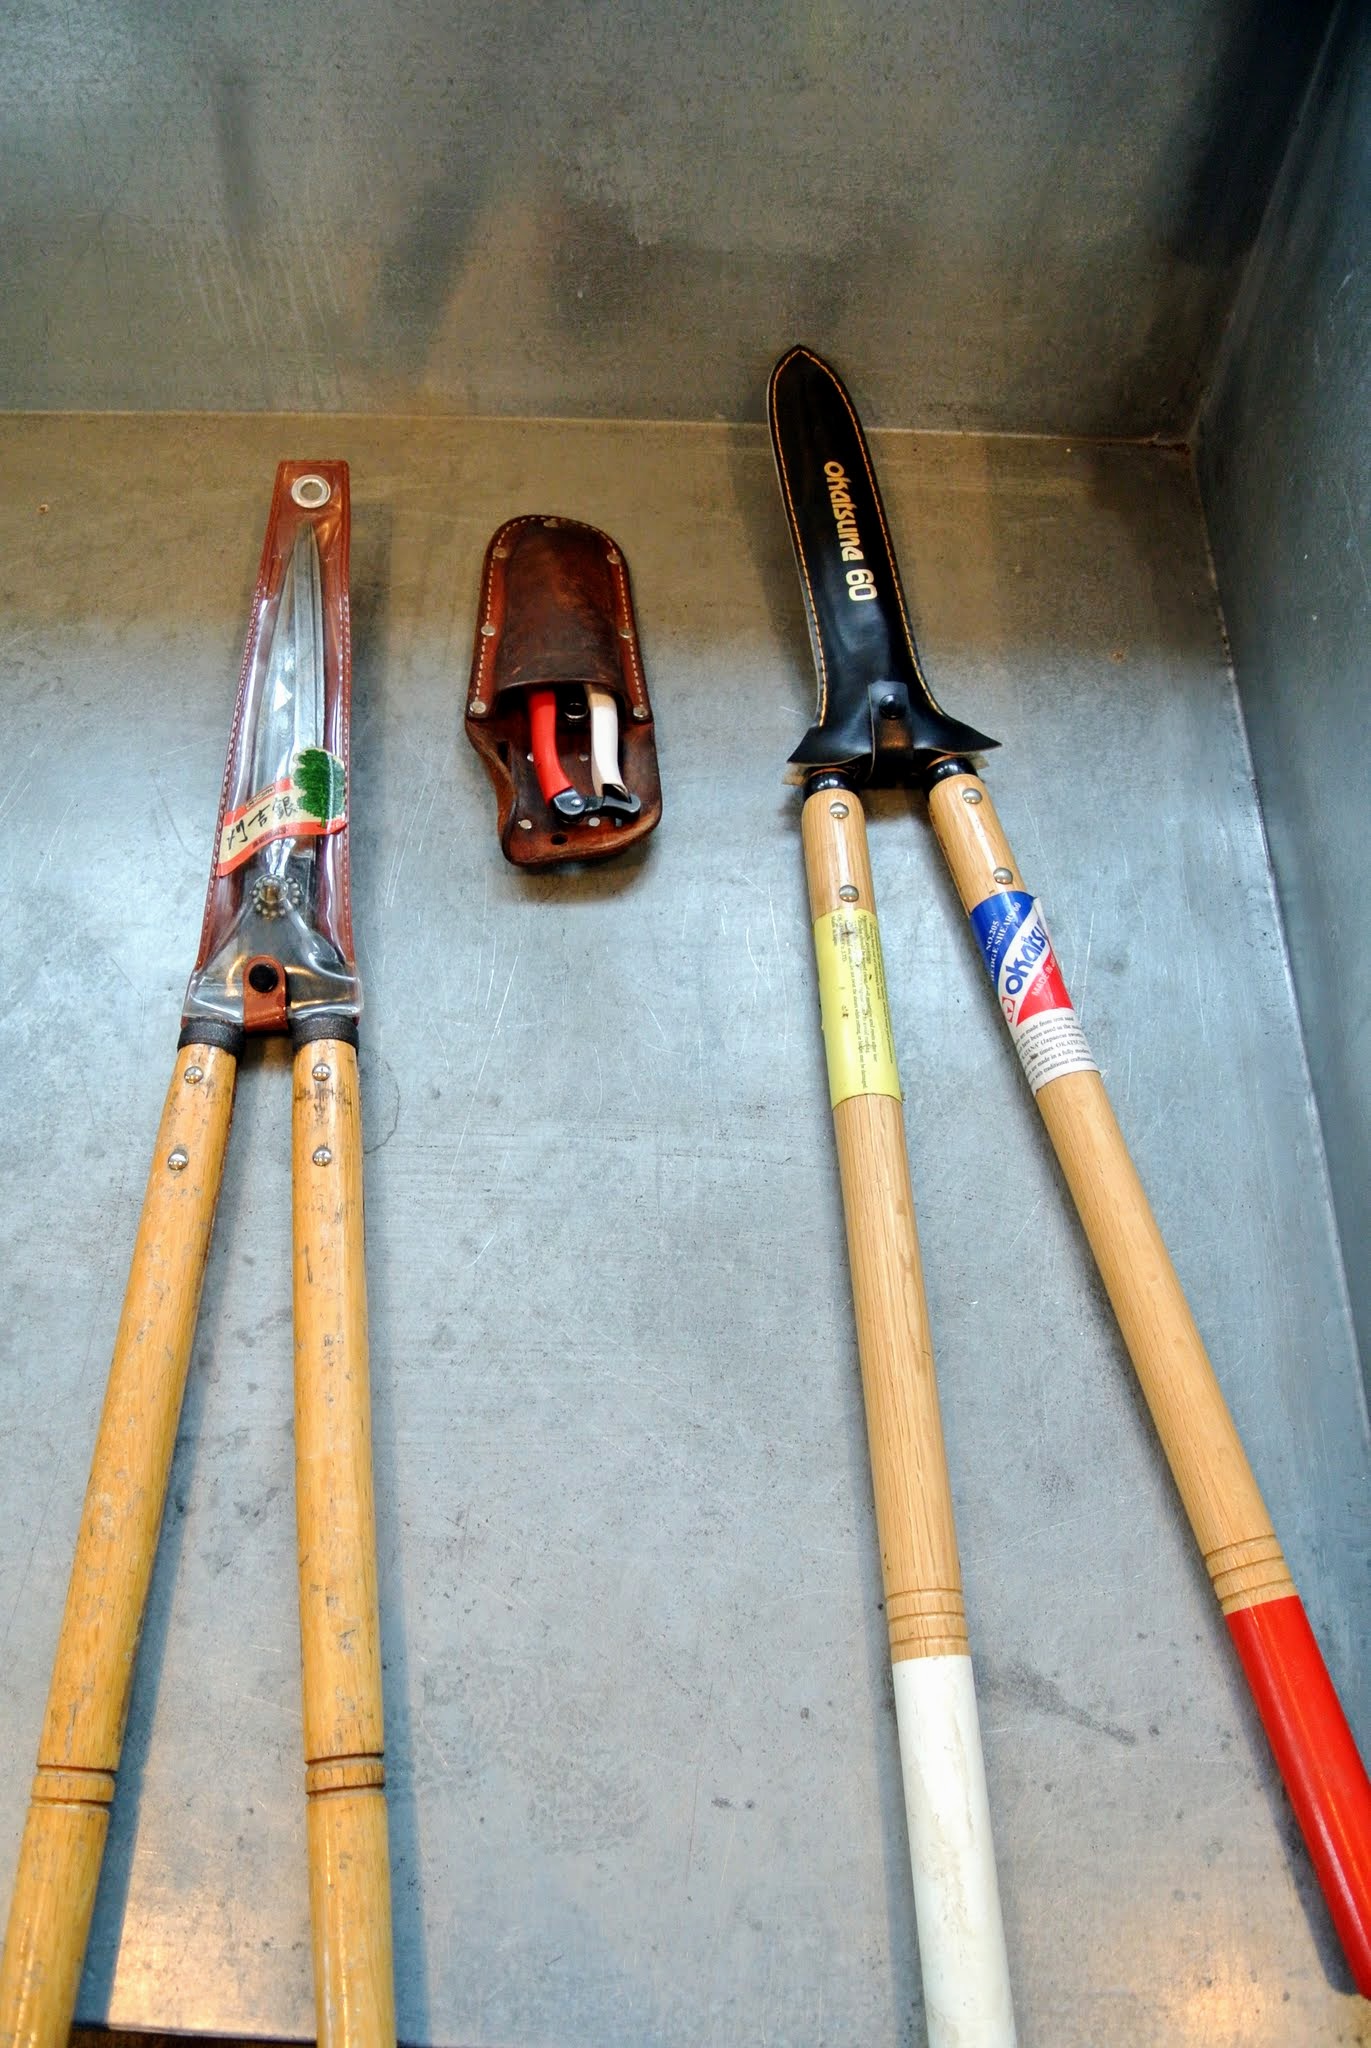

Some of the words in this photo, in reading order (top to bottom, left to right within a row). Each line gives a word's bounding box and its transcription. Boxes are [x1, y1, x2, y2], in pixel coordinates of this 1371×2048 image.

[824, 461, 864, 562] okatsune
[845, 568, 878, 602] 60
[1013, 902, 1022, 912] 60
[986, 920, 999, 951] NO.205
[1031, 972, 1050, 996] MADE
